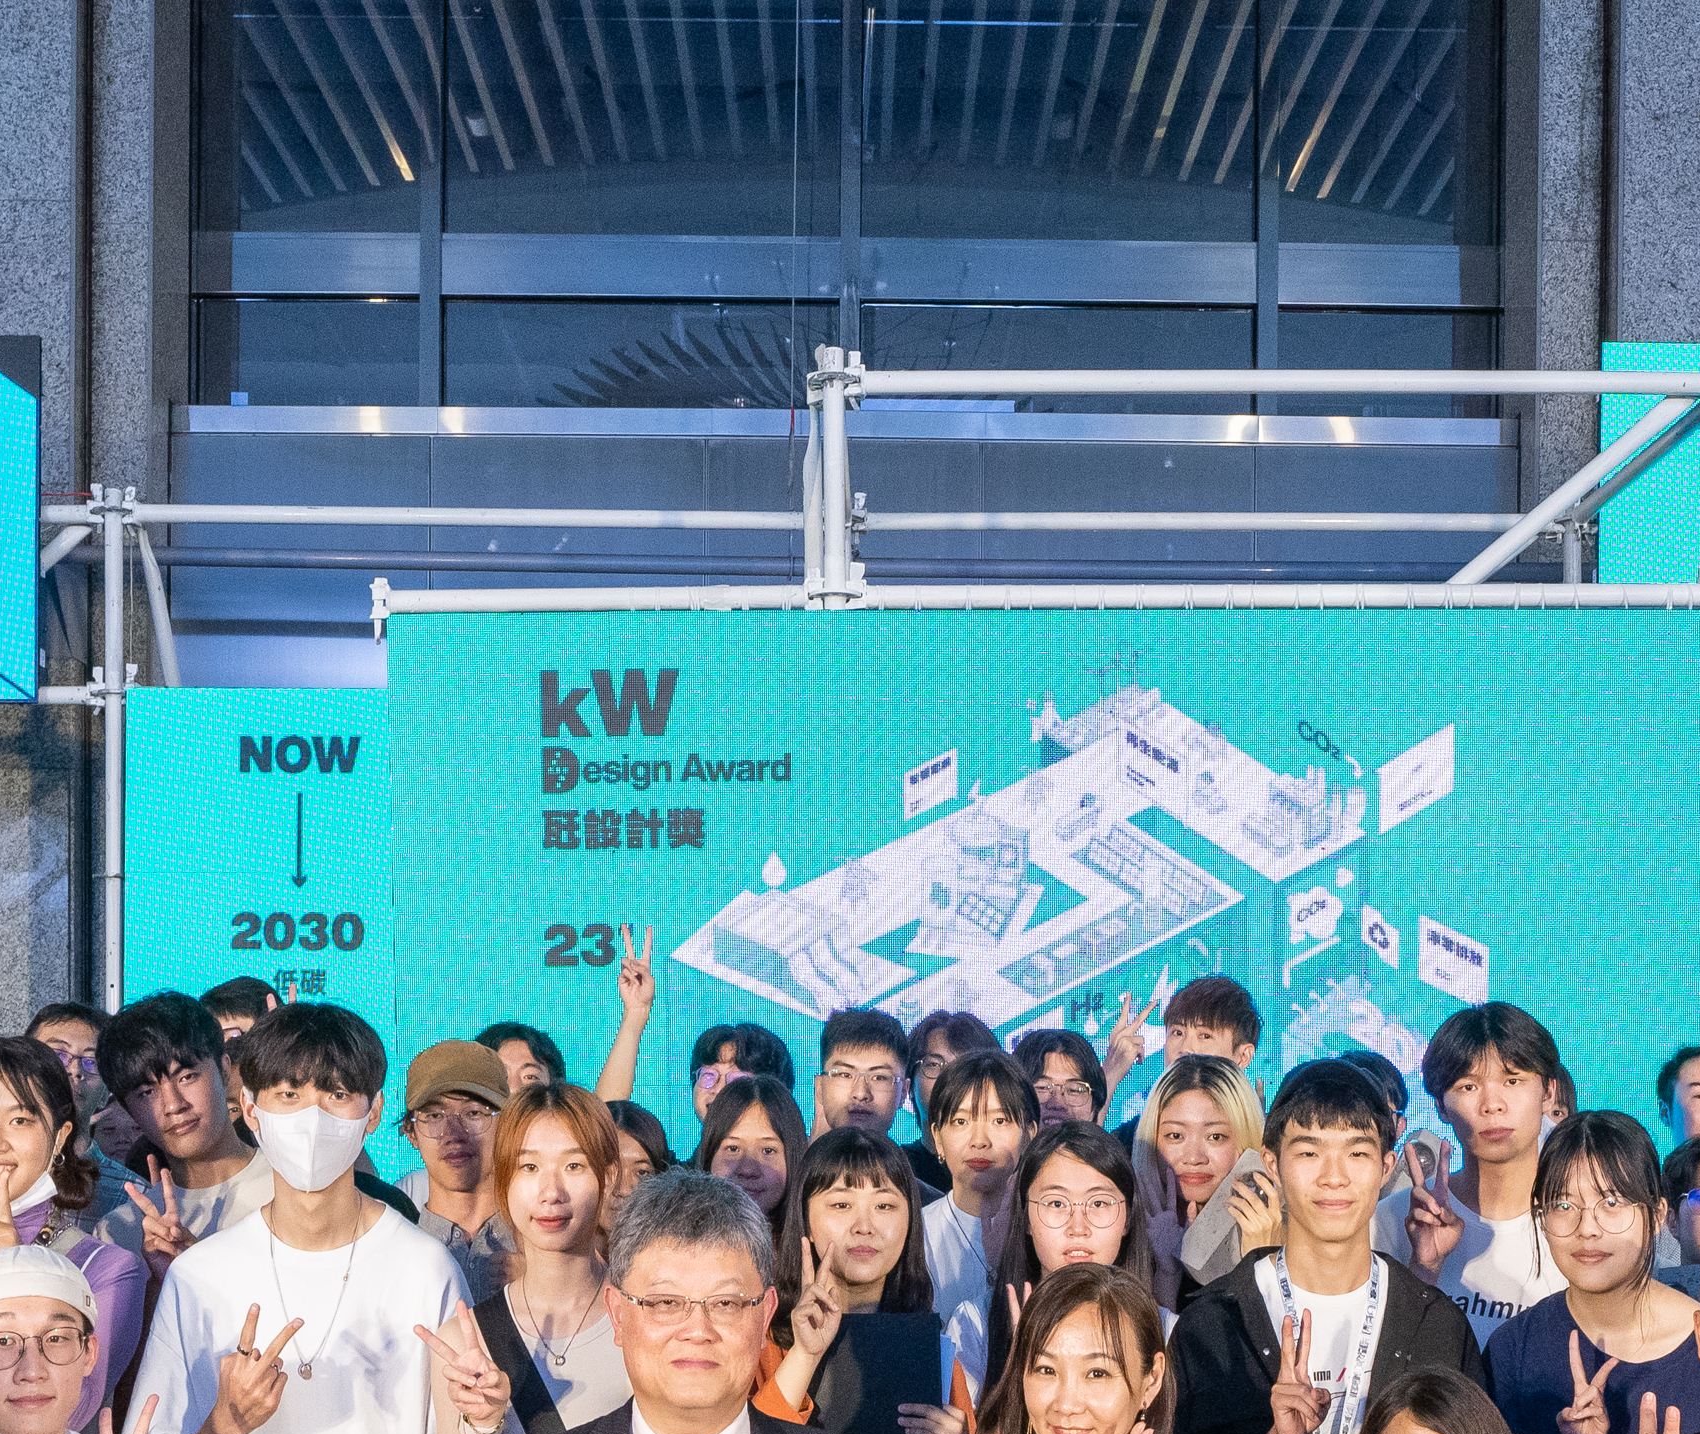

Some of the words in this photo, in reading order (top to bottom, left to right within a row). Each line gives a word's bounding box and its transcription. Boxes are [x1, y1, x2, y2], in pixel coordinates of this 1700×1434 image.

[540, 668, 679, 737] kW
[239, 735, 360, 774] NOW
[542, 746, 672, 793] Design
[681, 753, 791, 782] Award
[231, 911, 364, 951] 2030
